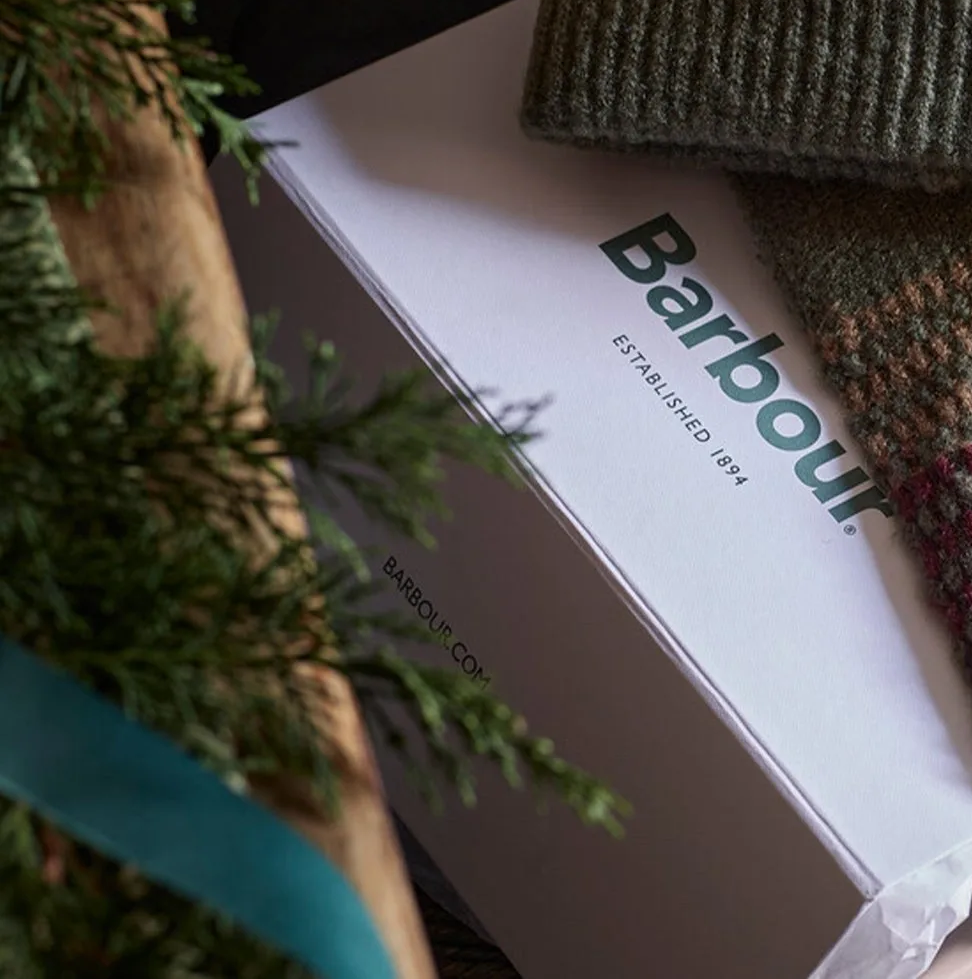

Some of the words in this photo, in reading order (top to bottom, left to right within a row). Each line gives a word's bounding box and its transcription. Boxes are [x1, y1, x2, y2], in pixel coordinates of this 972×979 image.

[598, 212, 894, 524] Barbour
[612, 334, 711, 443] ESTABLISHED
[711, 448, 748, 486] 1894
[383, 556, 491, 690] BARBOUR.COM
